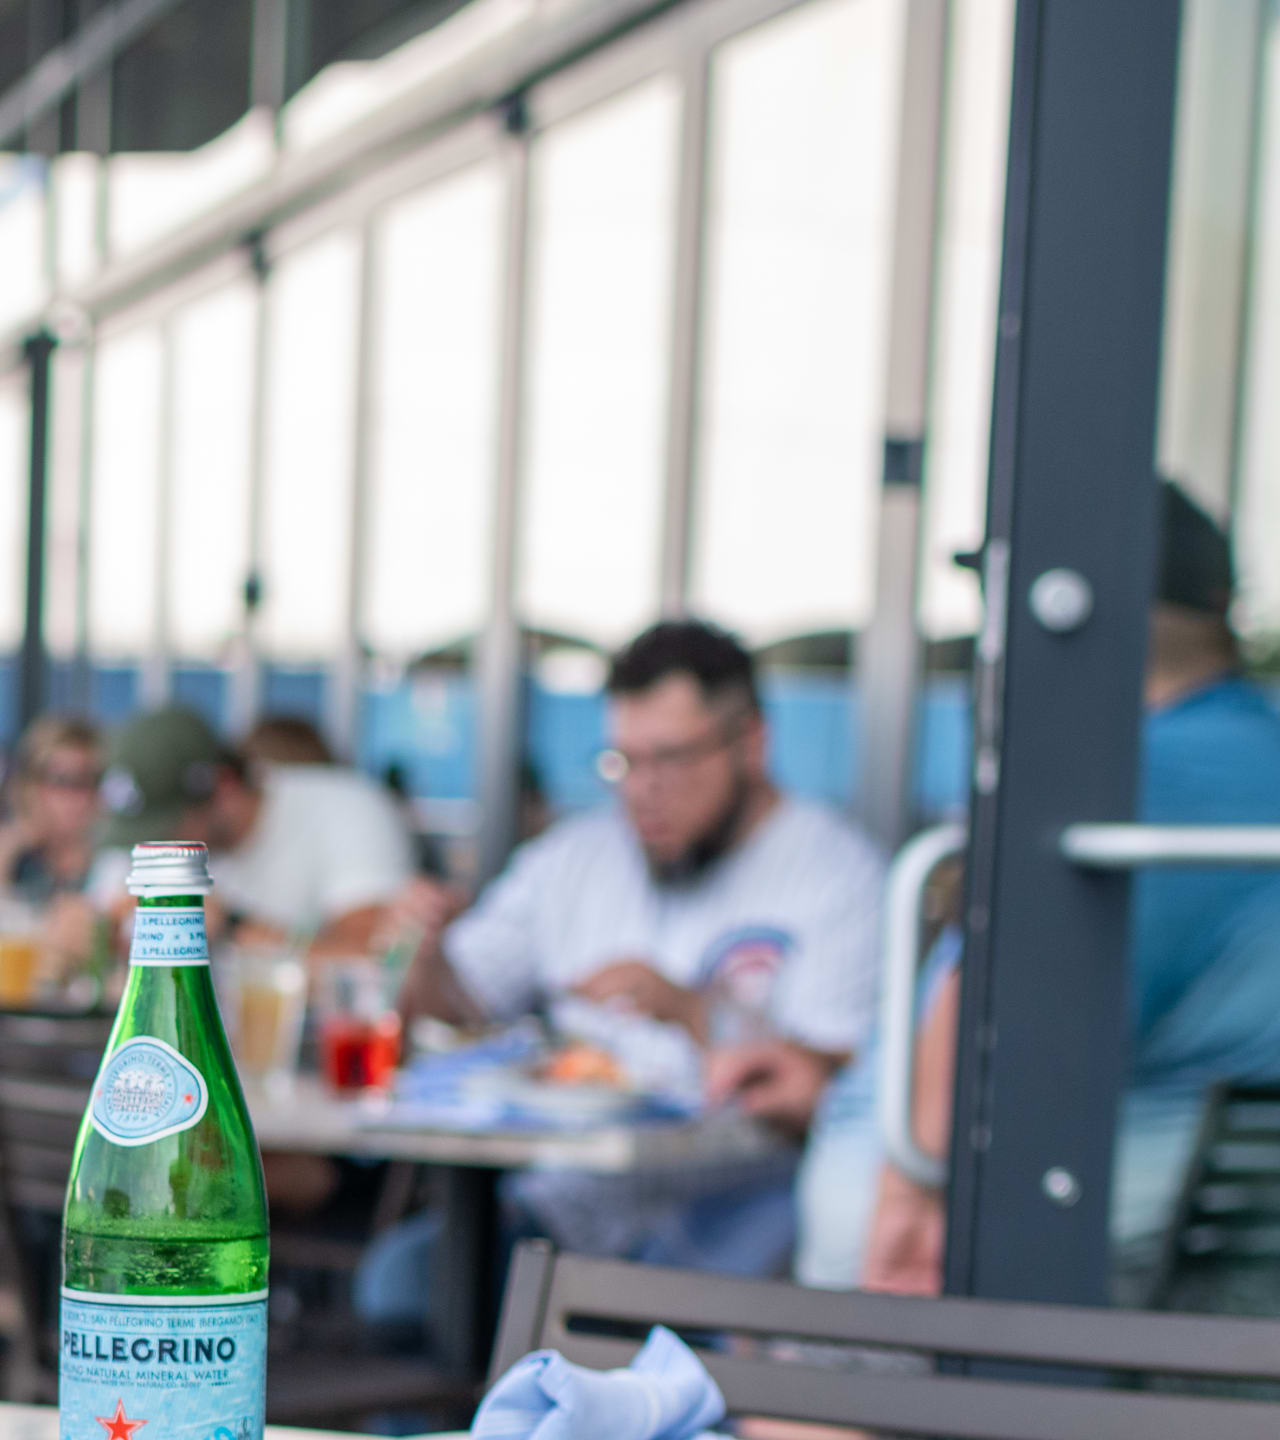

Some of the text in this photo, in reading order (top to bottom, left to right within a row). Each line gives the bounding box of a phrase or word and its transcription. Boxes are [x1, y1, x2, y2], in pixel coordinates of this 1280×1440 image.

[109, 1315, 164, 1328] PELLEGRINO
[167, 1318, 195, 1328] TERME
[63, 1329, 236, 1363] PELLEGRINO
[86, 1367, 131, 1380] NATURAL
[135, 1370, 189, 1382] MINERAL
[193, 1369, 230, 1380] WATER
